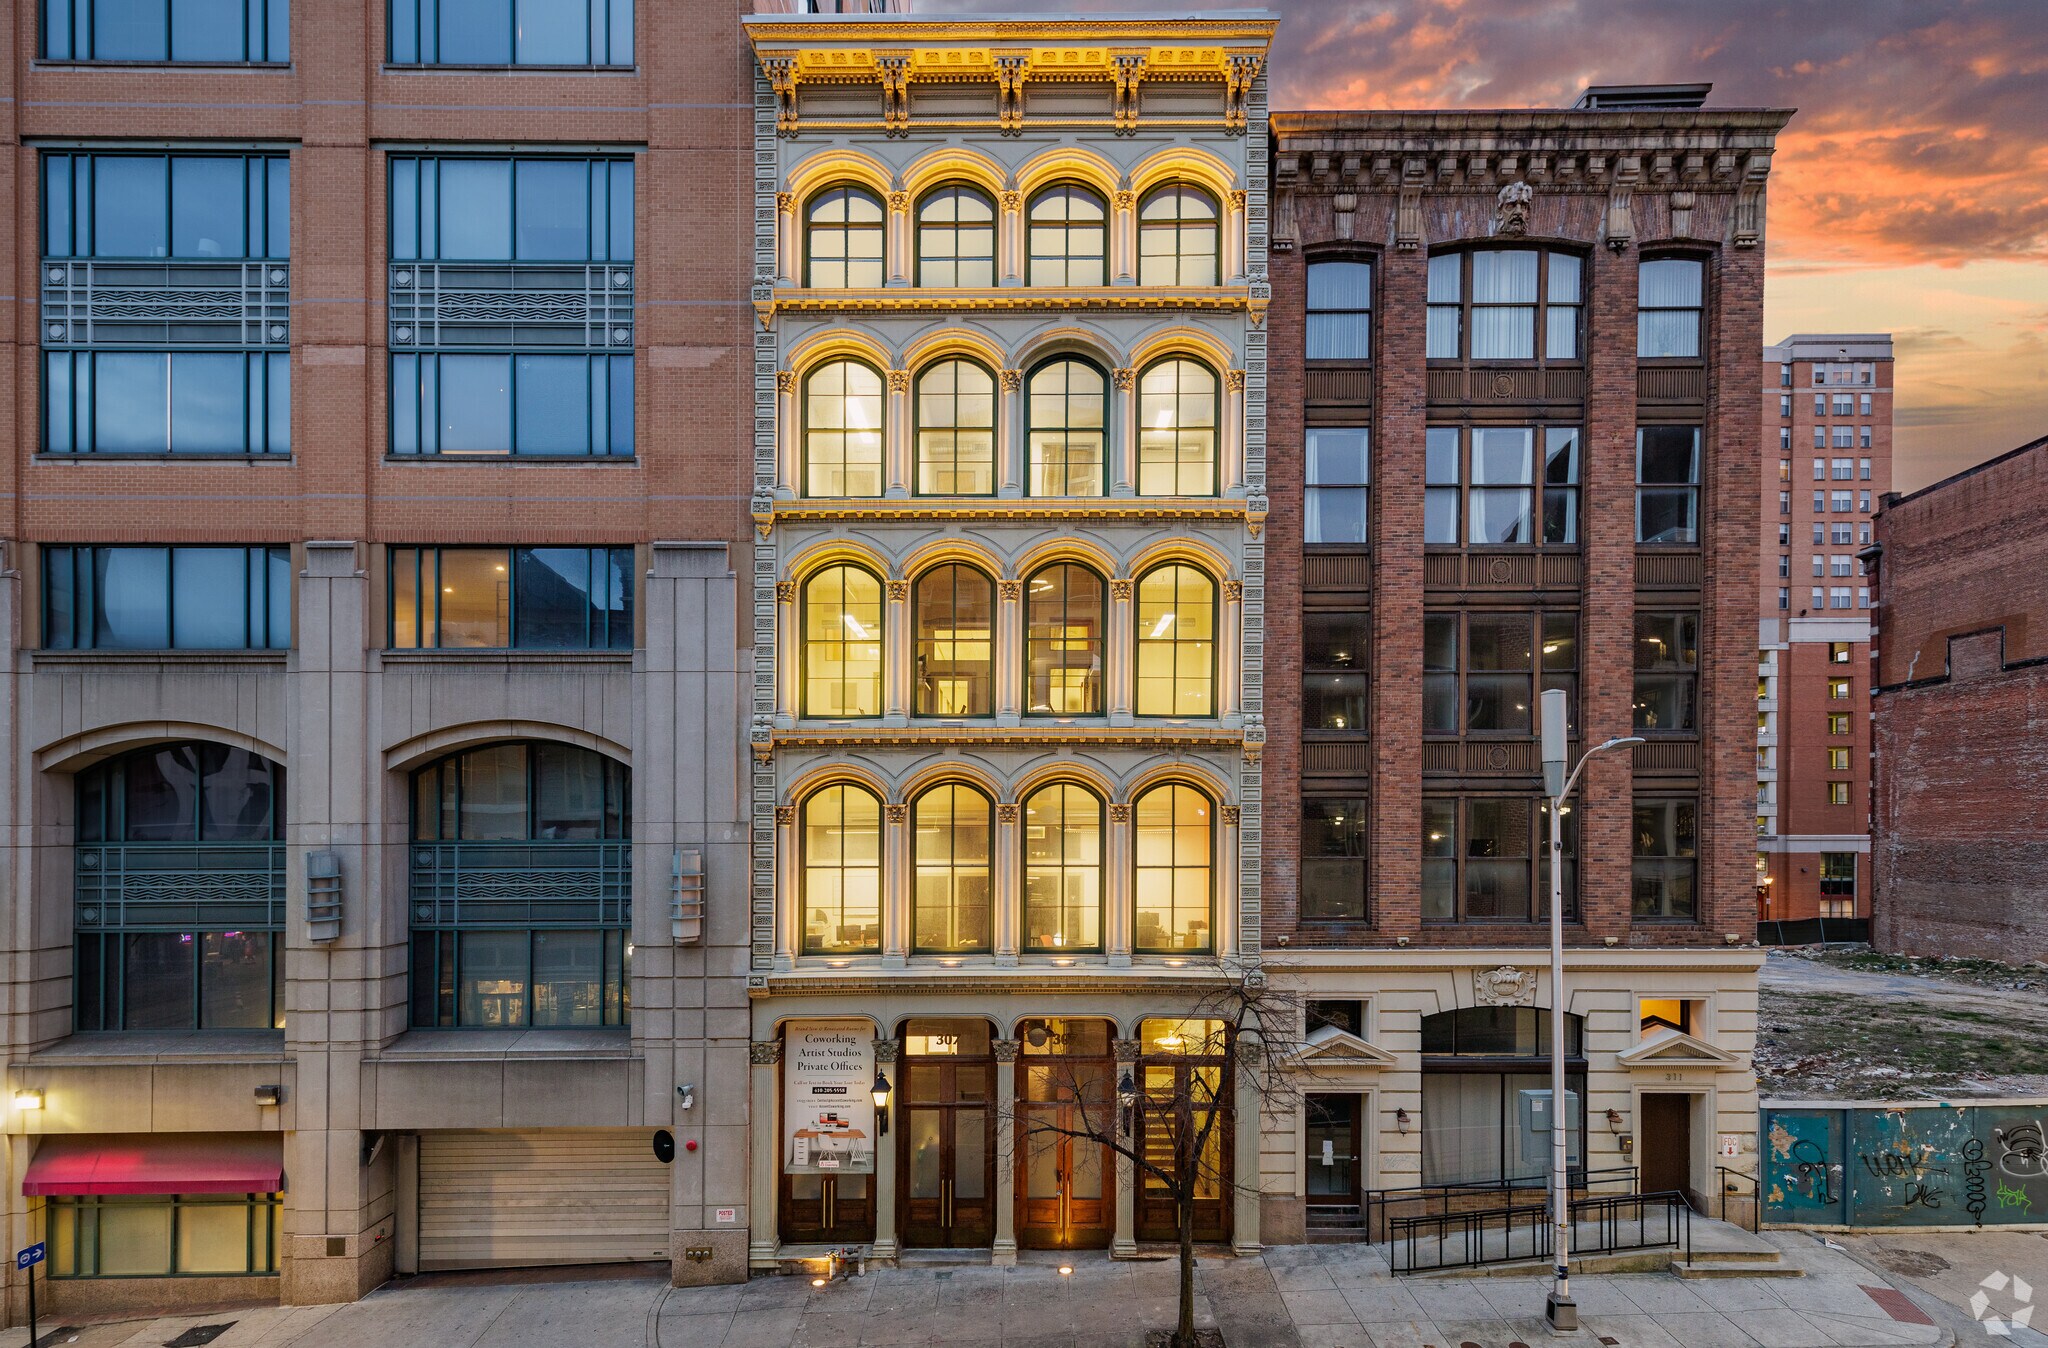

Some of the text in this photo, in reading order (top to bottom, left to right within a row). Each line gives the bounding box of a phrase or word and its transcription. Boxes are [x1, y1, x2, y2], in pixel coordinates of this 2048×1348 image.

[805, 1034, 856, 1046] Coworking
[936, 1034, 961, 1045] 307
[799, 1047, 862, 1057] Artist Studios
[797, 1060, 863, 1070] Private Offices
[1665, 1073, 1682, 1081] 311
[1724, 1137, 1737, 1146] FDC
